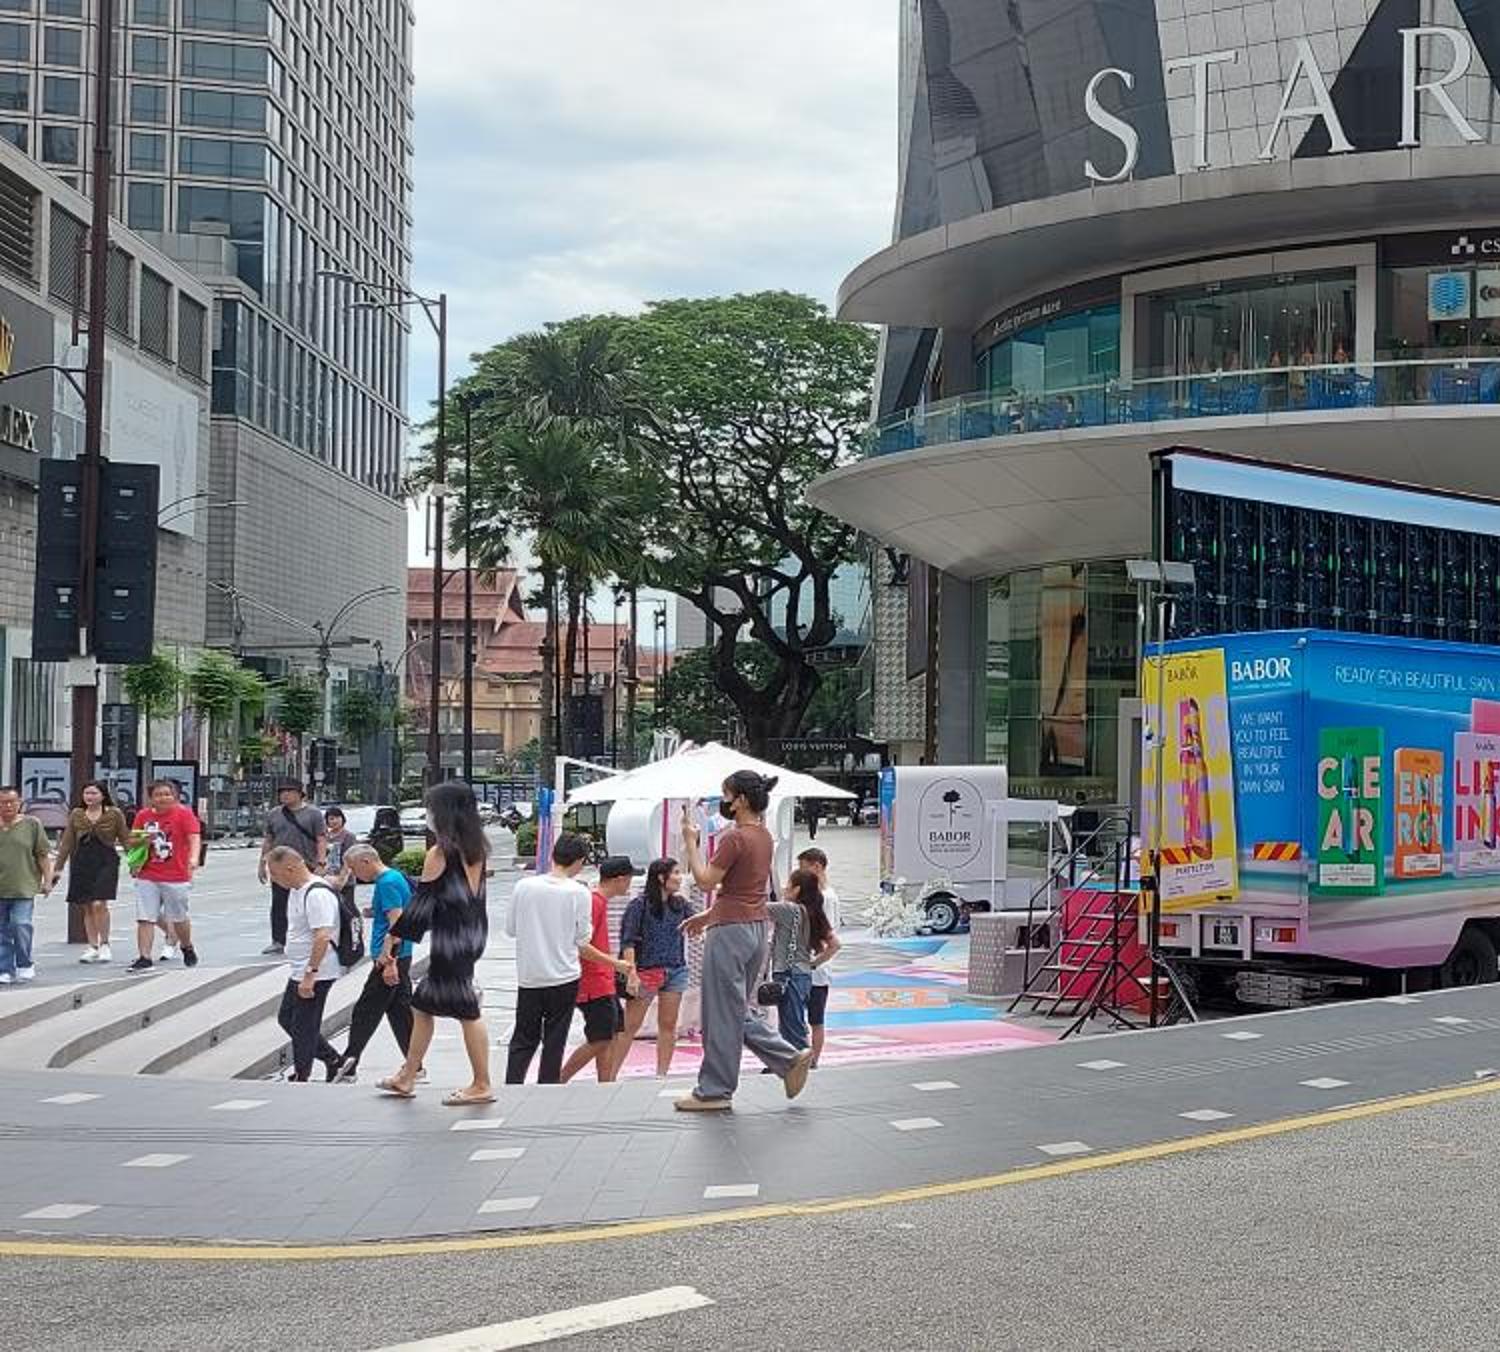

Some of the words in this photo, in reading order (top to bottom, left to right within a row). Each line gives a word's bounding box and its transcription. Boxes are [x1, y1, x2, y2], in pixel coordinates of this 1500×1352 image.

[1232, 657, 1293, 682] BABOR
[1335, 665, 1374, 684] READY
[1378, 669, 1403, 687] FOR
[1405, 671, 1466, 691] BEAUTIFUL
[1470, 674, 1493, 692] SKIN
[1241, 713, 1257, 727] WE
[1258, 711, 1284, 725] WANT
[1233, 729, 1252, 744] YOU
[1254, 729, 1267, 743] TO
[1269, 727, 1291, 742] FEEL
[1238, 746, 1285, 761] BEAUTIFUL
[1243, 763, 1253, 777] IN
[25, 776, 67, 803] 15
[1239, 780, 1261, 794] OWN
[1320, 808, 1376, 852] AR
